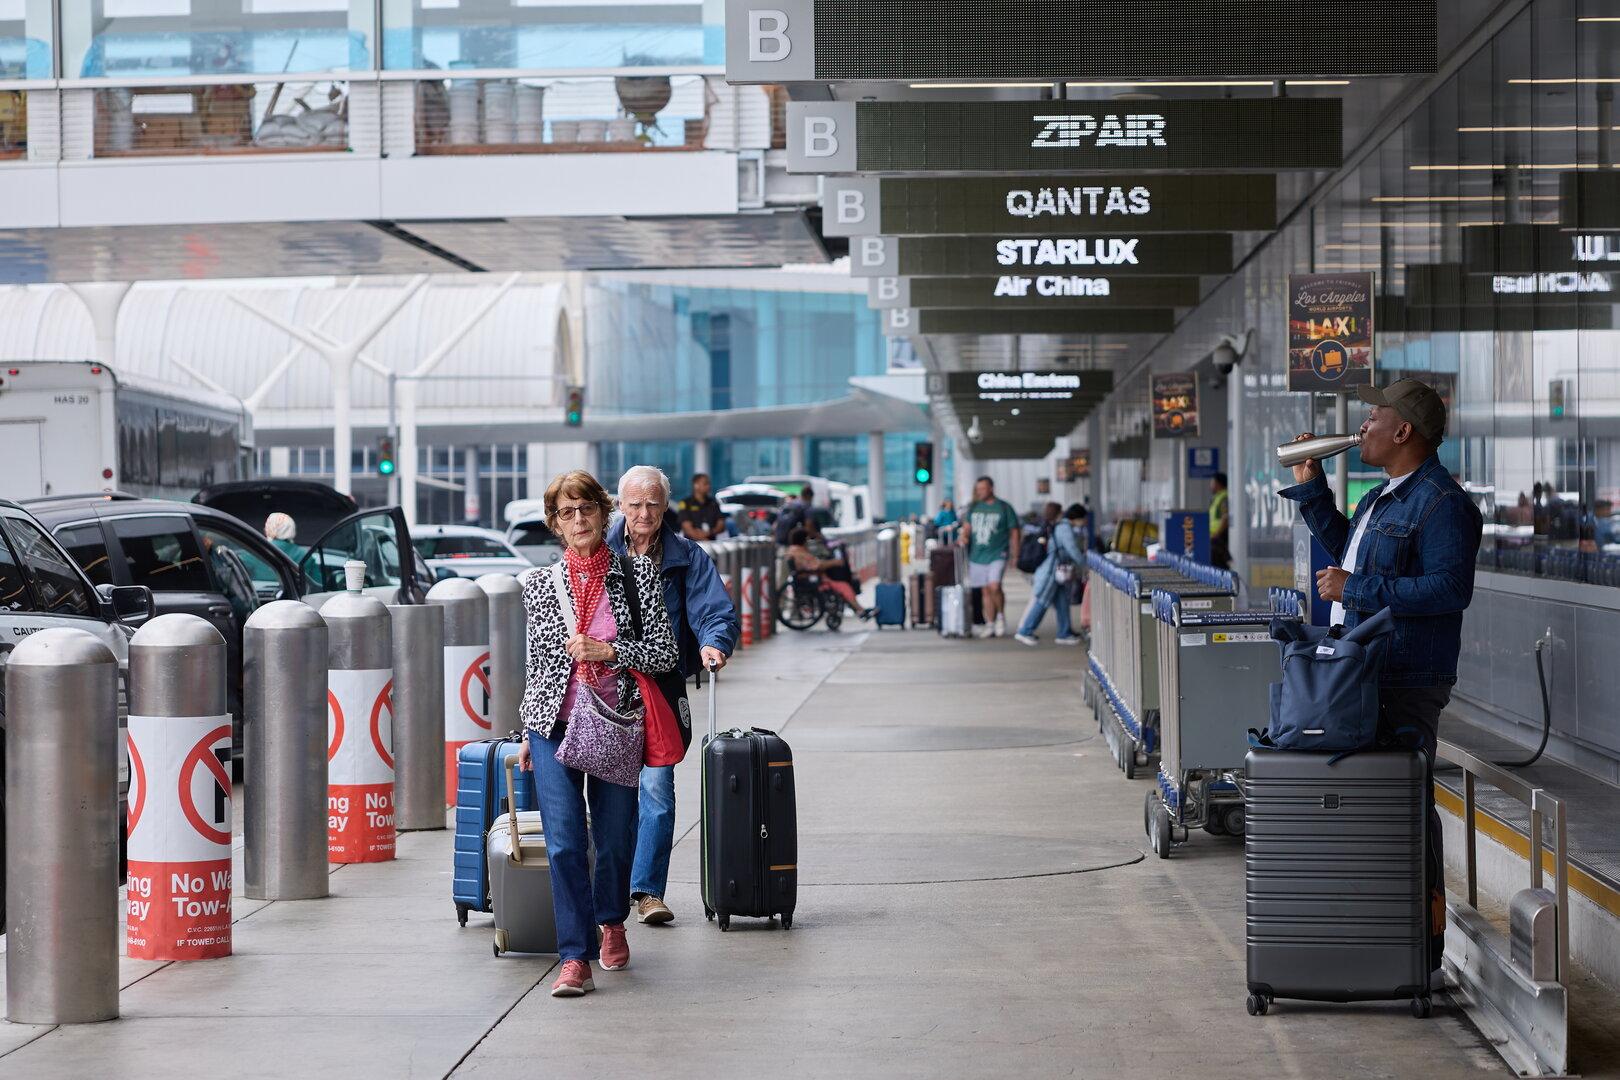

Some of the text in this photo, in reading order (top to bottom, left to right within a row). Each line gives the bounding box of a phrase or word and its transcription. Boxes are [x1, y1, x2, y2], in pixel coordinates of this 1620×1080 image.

[749, 9, 792, 62] B
[804, 116, 839, 158] B
[837, 190, 866, 223] B
[861, 237, 886, 266] B
[996, 238, 1140, 265] STARLUX
[878, 276, 899, 300] B
[994, 276, 1110, 297] Air China
[1295, 290, 1366, 308] Los Angeles
[890, 308, 910, 328] B
[54, 394, 75, 404] HAS
[365, 793, 387, 810] No
[171, 873, 205, 893] No
[176, 939, 186, 947] IF
[187, 937, 215, 947] TOWED
